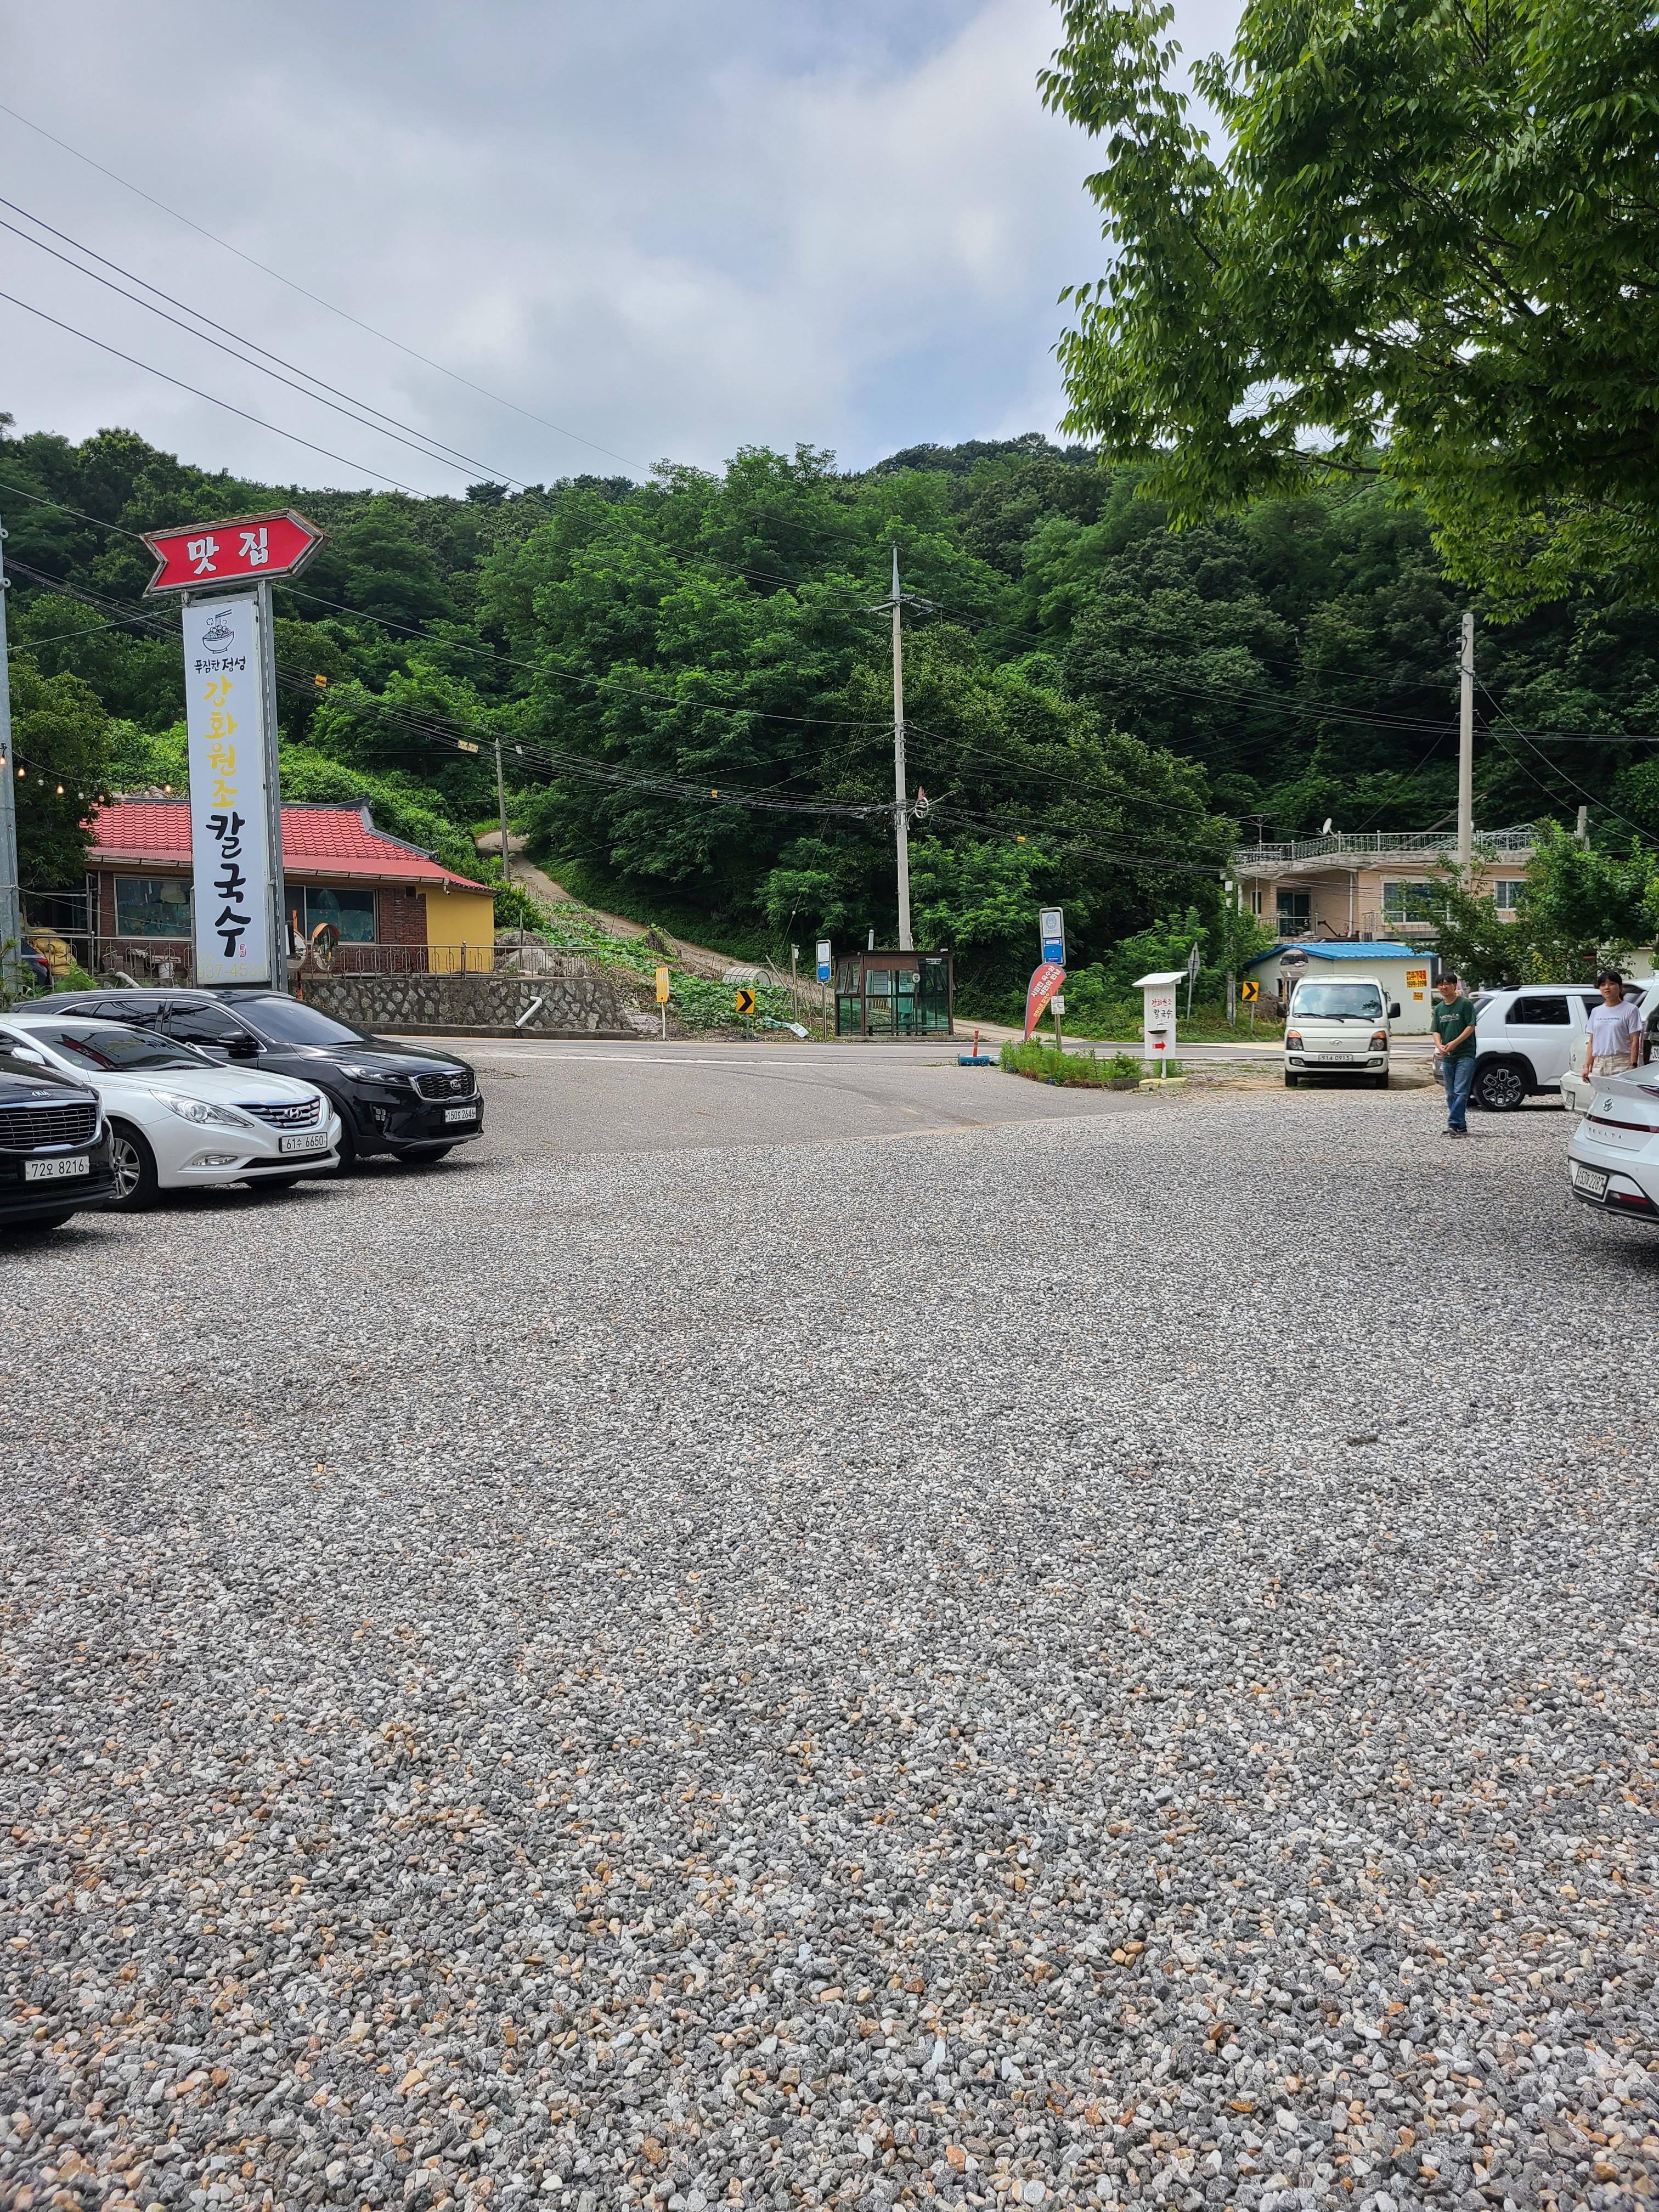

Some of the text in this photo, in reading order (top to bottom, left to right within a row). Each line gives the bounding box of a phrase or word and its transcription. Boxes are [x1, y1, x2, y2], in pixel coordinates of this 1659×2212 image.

[187, 527, 268, 575] 맛집
[194, 654, 246, 674] 푸짐한 정성
[204, 675, 251, 957] 강화원조 칼국수
[1153, 1009, 1172, 1019] 칼국수
[448, 1109, 475, 1121] 150오 2646
[286, 1135, 323, 1149] 61수 6650
[31, 1159, 84, 1177] 72오 8216
[1589, 1174, 1604, 1191] 2287
